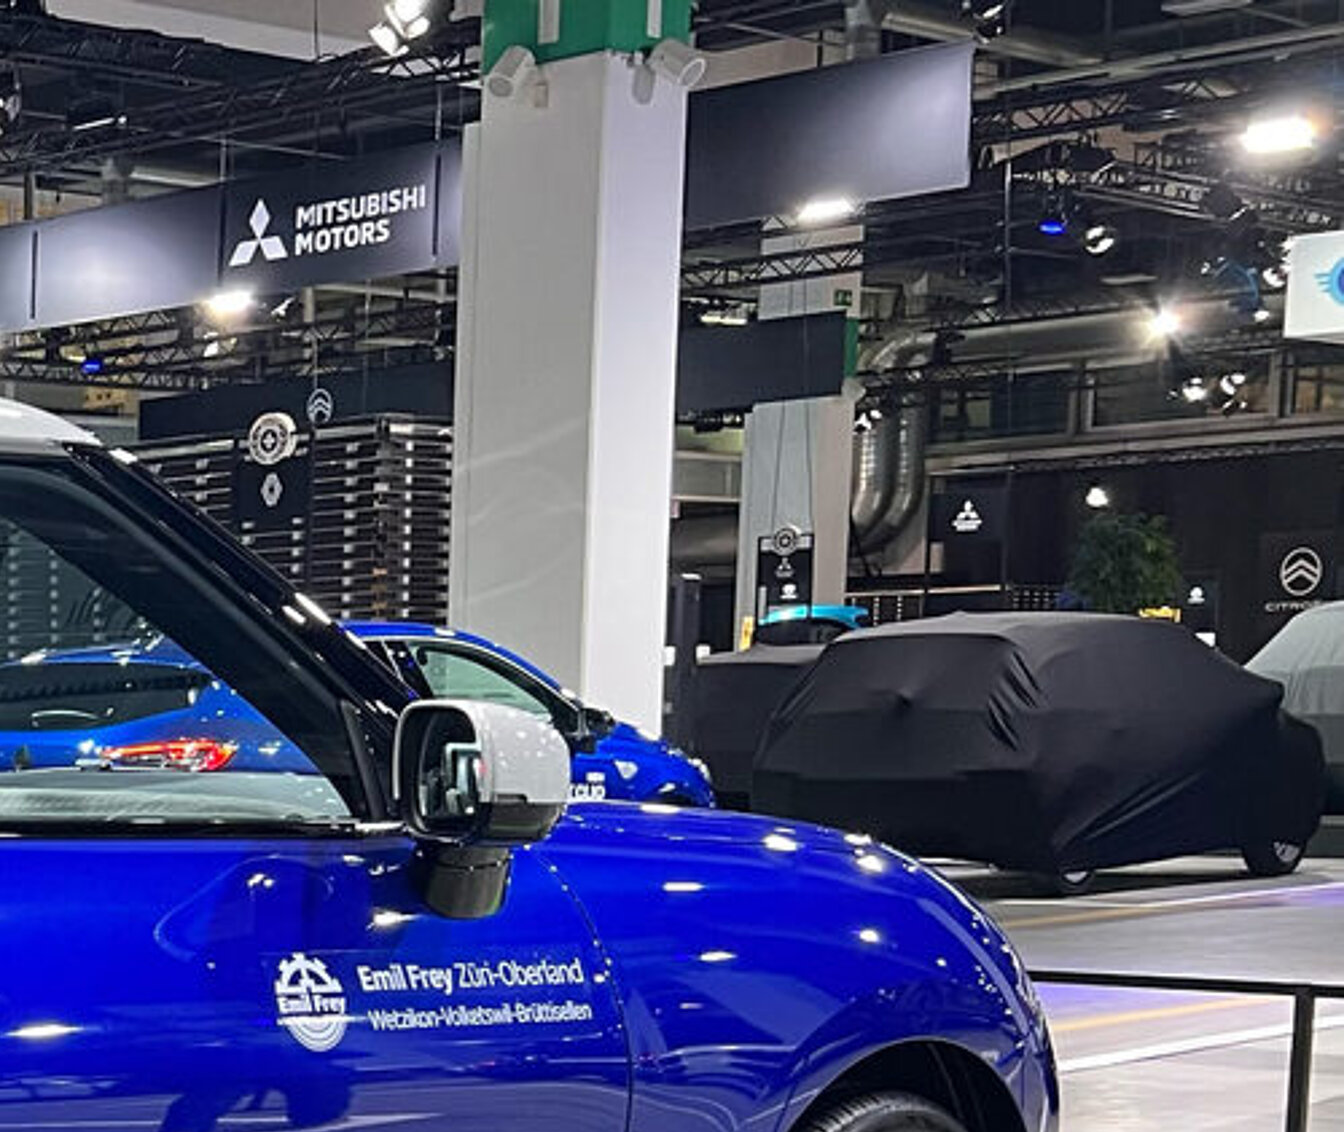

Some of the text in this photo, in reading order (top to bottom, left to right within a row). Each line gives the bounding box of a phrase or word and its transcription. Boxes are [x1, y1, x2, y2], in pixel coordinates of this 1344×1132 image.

[295, 184, 426, 230] MITSUBISHI
[294, 219, 391, 256] MOTORS
[357, 957, 585, 996] Emil Frey Züri-Oberland
[277, 994, 346, 1015] Emil Frey
